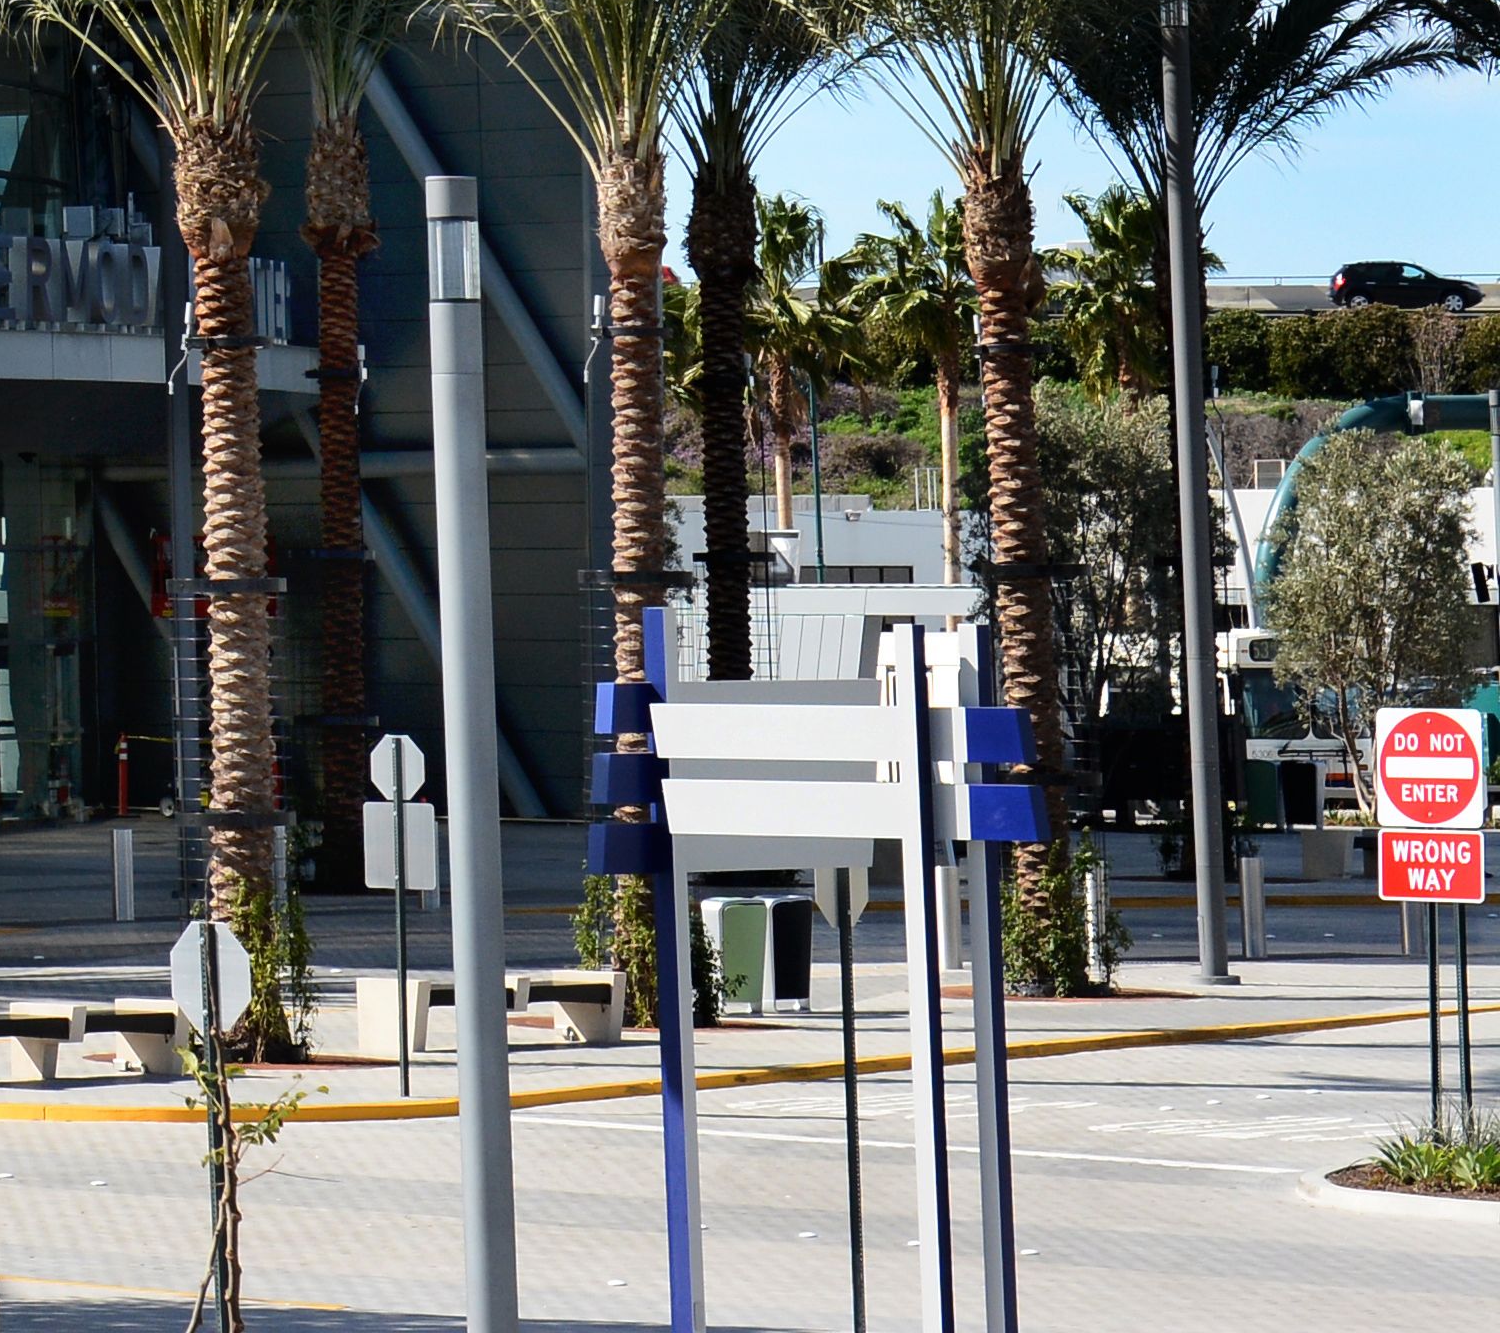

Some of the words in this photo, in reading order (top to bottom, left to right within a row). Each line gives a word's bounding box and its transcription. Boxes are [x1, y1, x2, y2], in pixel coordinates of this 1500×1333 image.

[1394, 733, 1419, 751] DO
[1430, 734, 1465, 753] NOT
[1401, 784, 1459, 803] ENTER
[1392, 840, 1471, 864] WRONG
[1407, 868, 1455, 891] WAY
